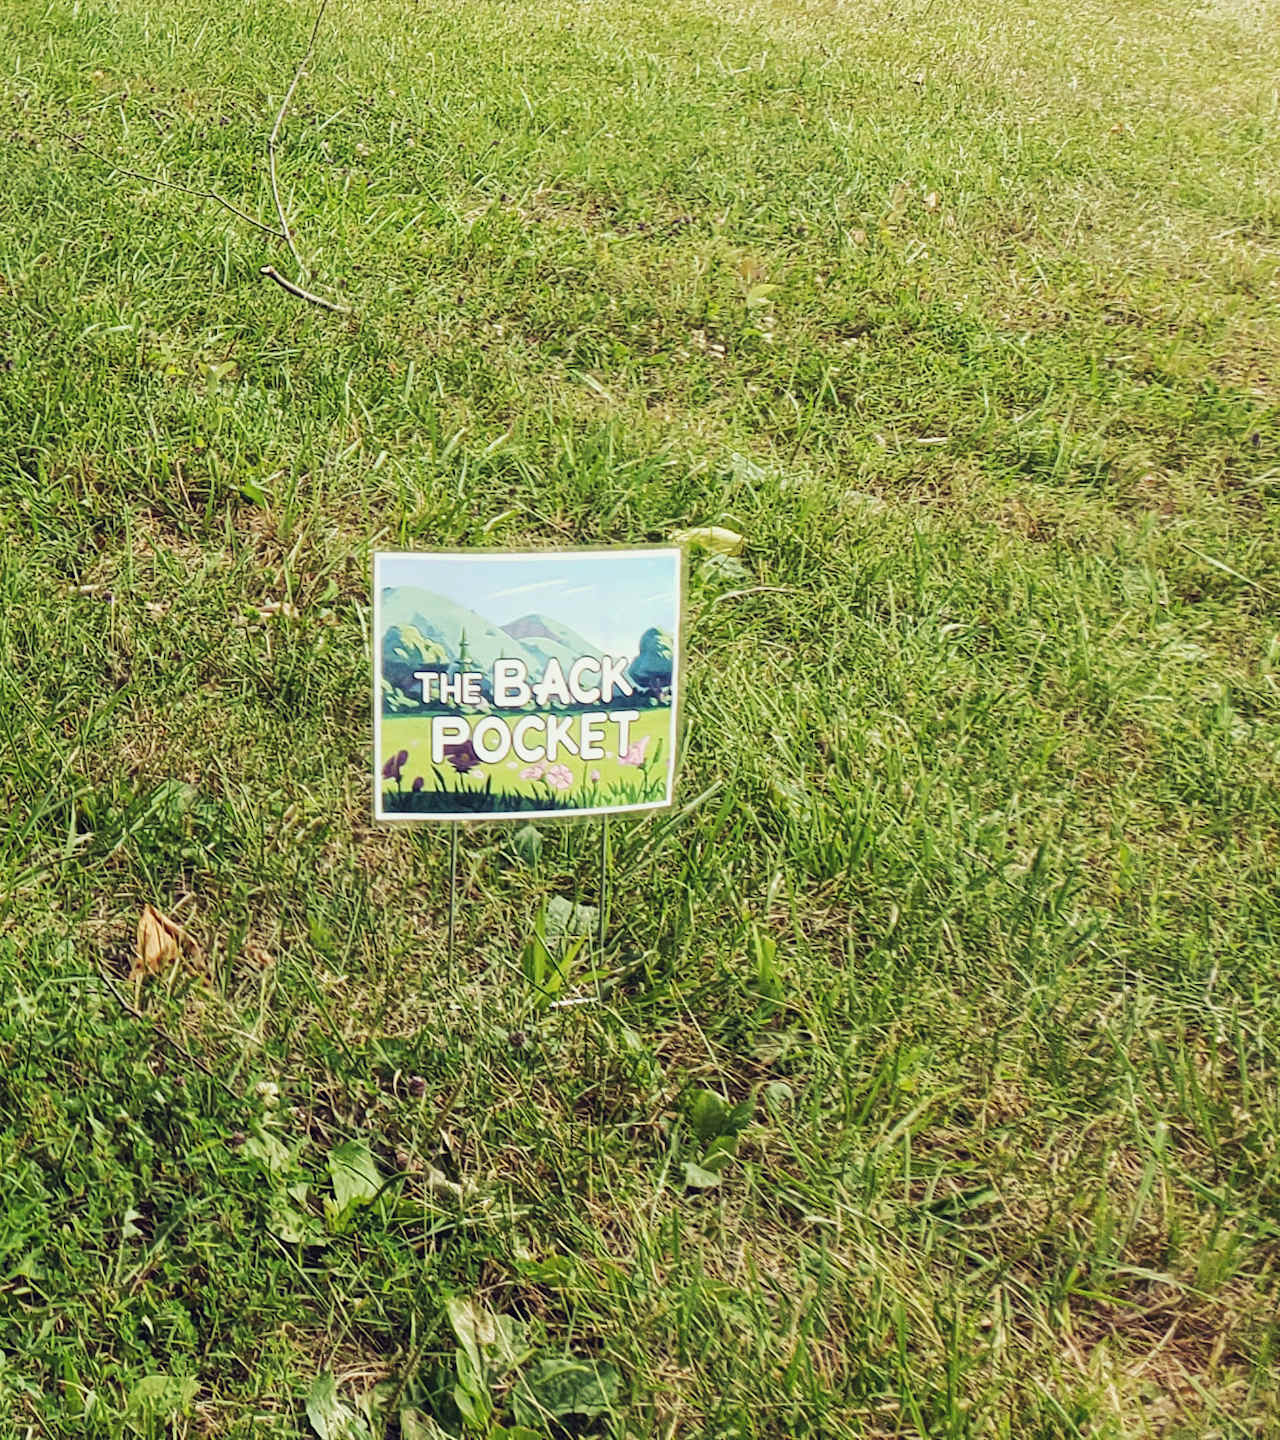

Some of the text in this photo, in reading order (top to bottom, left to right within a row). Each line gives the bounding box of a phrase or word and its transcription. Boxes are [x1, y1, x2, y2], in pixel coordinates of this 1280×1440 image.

[414, 655, 634, 707] THE BACK
[431, 710, 639, 764] POCKET
